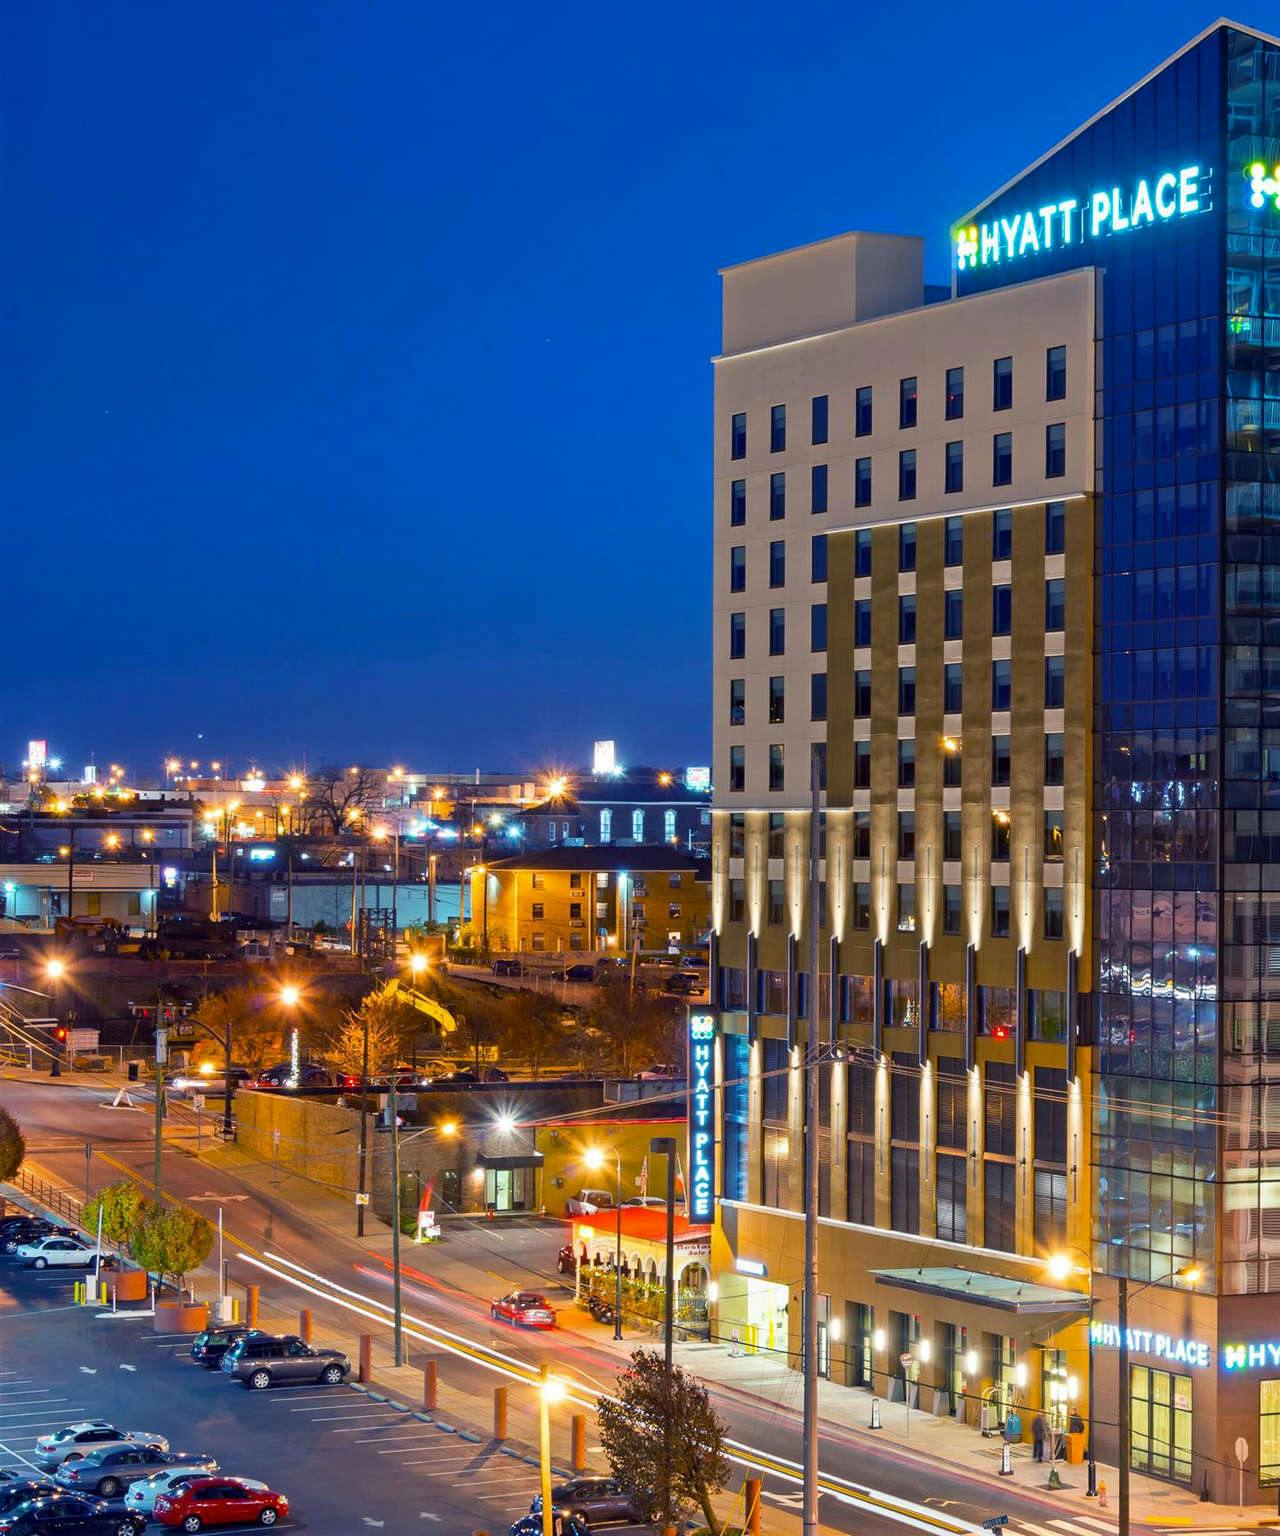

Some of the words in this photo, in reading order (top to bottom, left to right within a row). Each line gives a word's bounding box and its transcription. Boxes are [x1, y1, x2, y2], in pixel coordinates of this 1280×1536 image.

[981, 199, 1077, 265] HYATT
[1091, 165, 1200, 237] PLACE
[695, 1044, 710, 1126] HYATT
[695, 1132, 710, 1216] PLACE
[1155, 1333, 1210, 1367] PLACE
